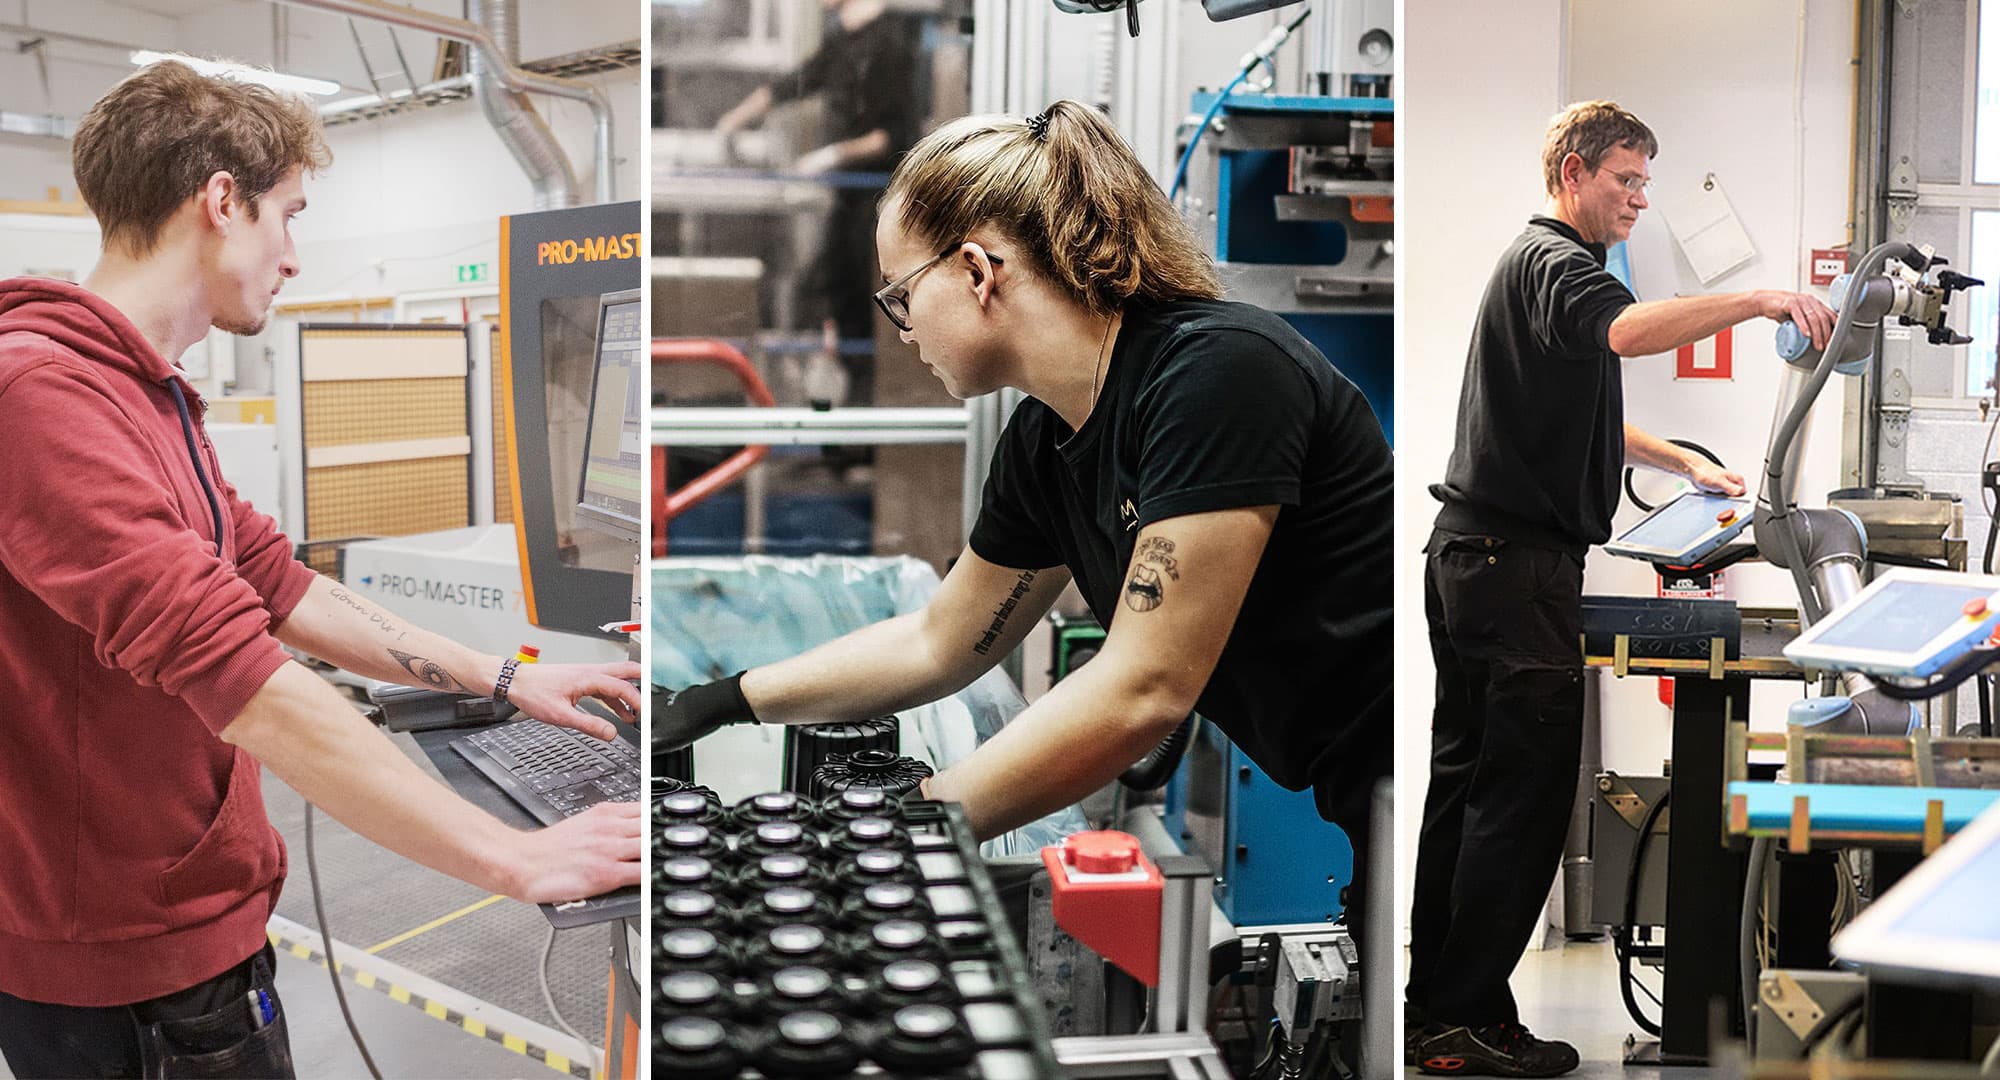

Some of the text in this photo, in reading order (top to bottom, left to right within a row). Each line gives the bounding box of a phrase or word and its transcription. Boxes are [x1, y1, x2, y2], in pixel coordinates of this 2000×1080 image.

[537, 232, 641, 266] PRO-MAST
[1008, 580, 1031, 600] wings
[1018, 570, 1034, 583] for
[380, 574, 505, 611] PRO-MASTER
